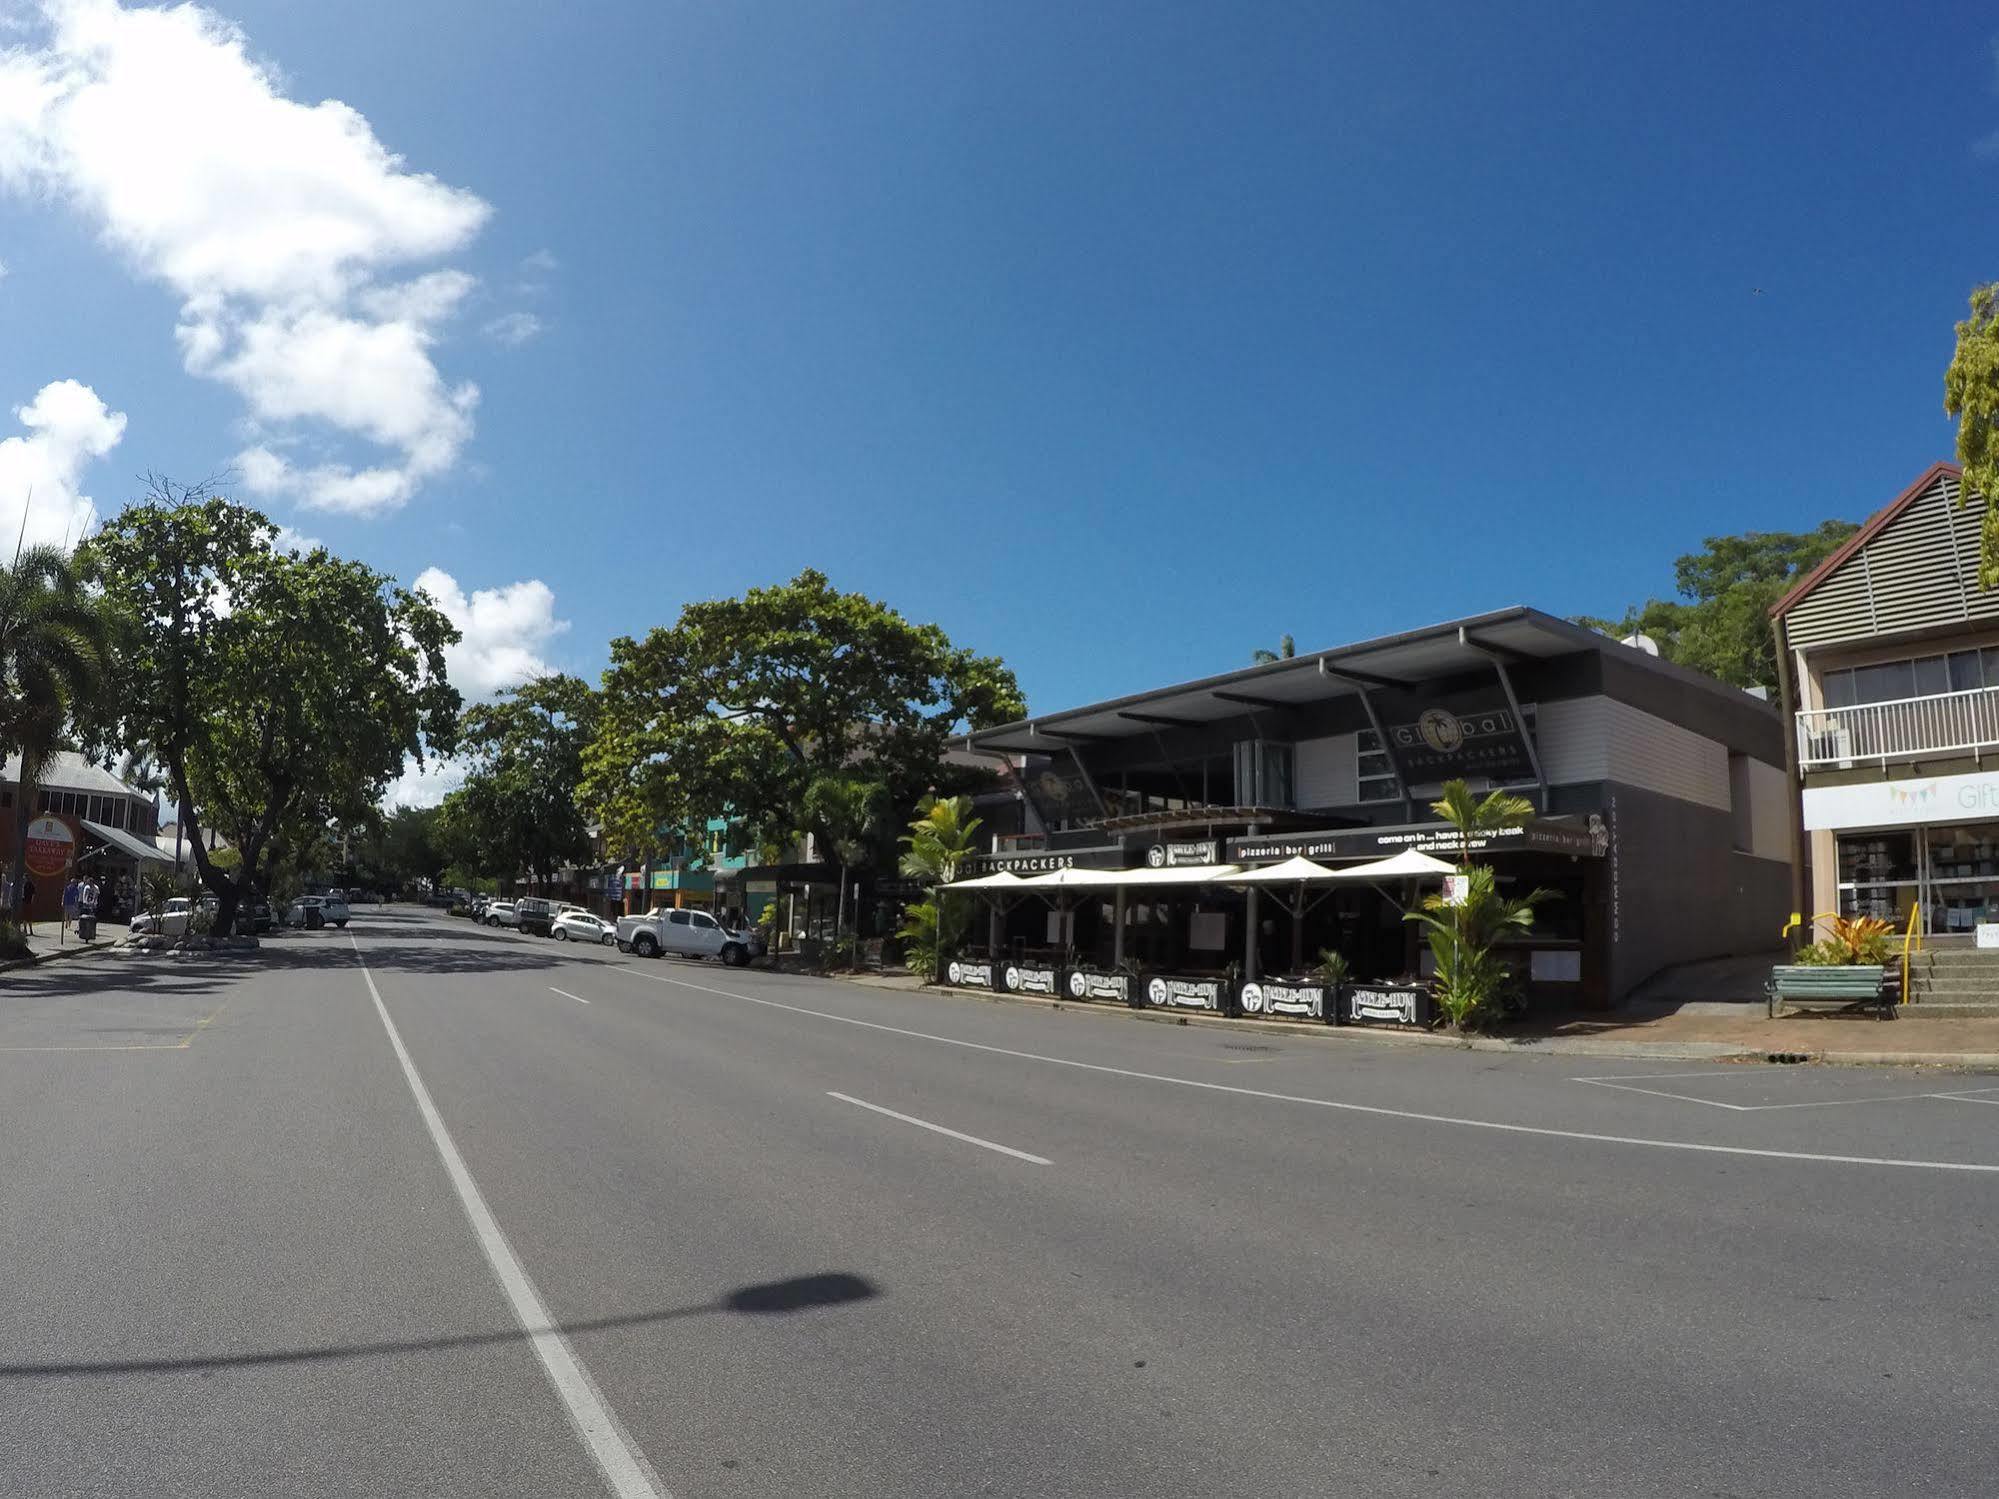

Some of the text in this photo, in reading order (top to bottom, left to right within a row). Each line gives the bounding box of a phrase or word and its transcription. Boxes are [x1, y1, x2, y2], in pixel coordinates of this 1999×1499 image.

[1378, 836, 1404, 844] come
[1435, 831, 1458, 840] have
[1241, 843, 1333, 858] pizzeria bar grill
[982, 856, 1073, 872] BACKPACKERS
